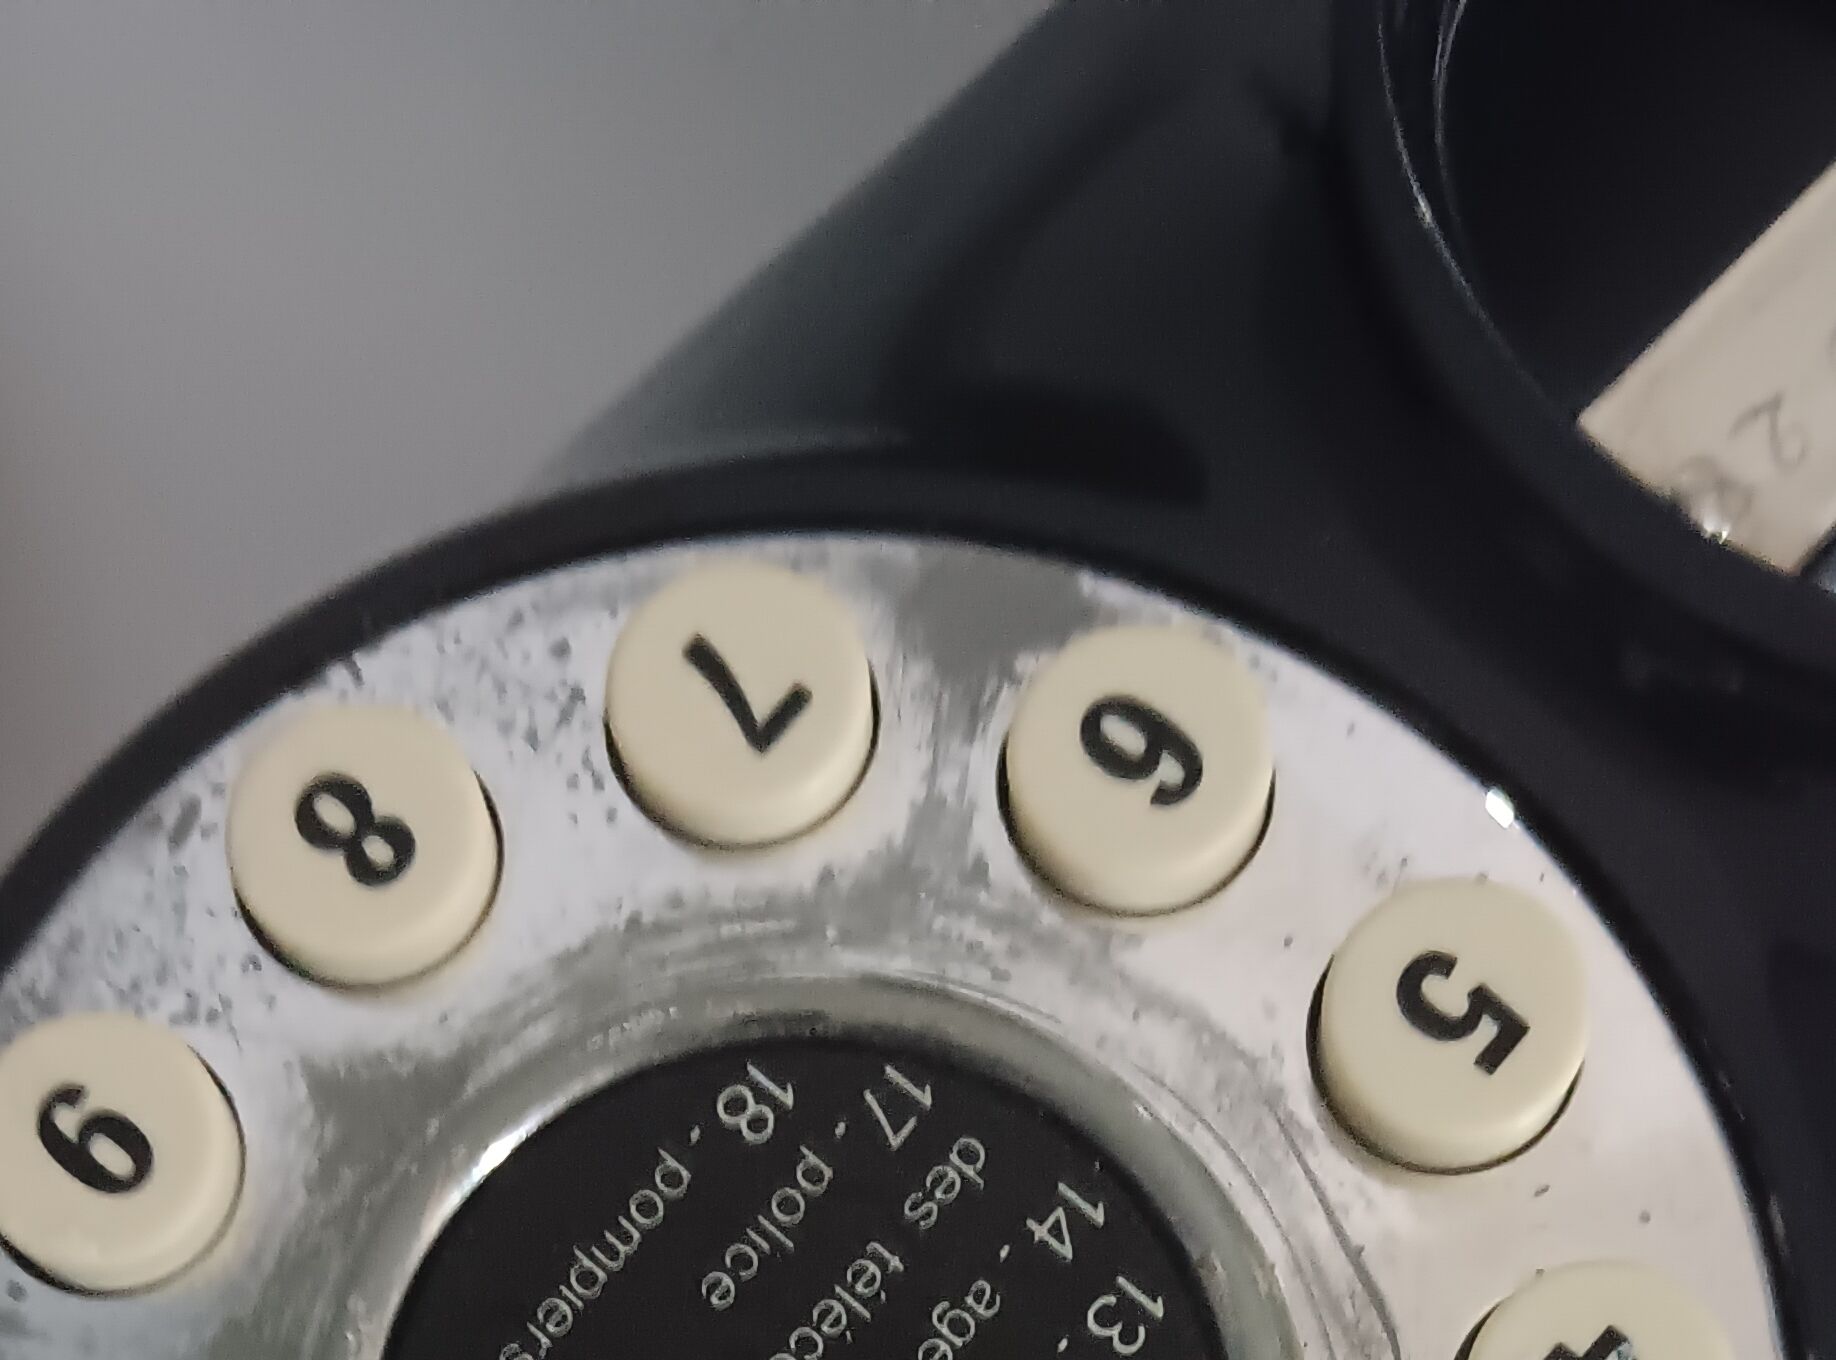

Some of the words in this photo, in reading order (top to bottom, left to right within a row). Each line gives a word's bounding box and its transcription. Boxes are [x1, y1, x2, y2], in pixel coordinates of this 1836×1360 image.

[682, 635, 813, 755] 7
[1079, 694, 1204, 807] 6
[294, 772, 416, 888] 8
[1396, 950, 1531, 1076] 5
[35, 1083, 154, 1195] 9
[903, 1137, 986, 1231] des
[701, 1145, 834, 1309] police
